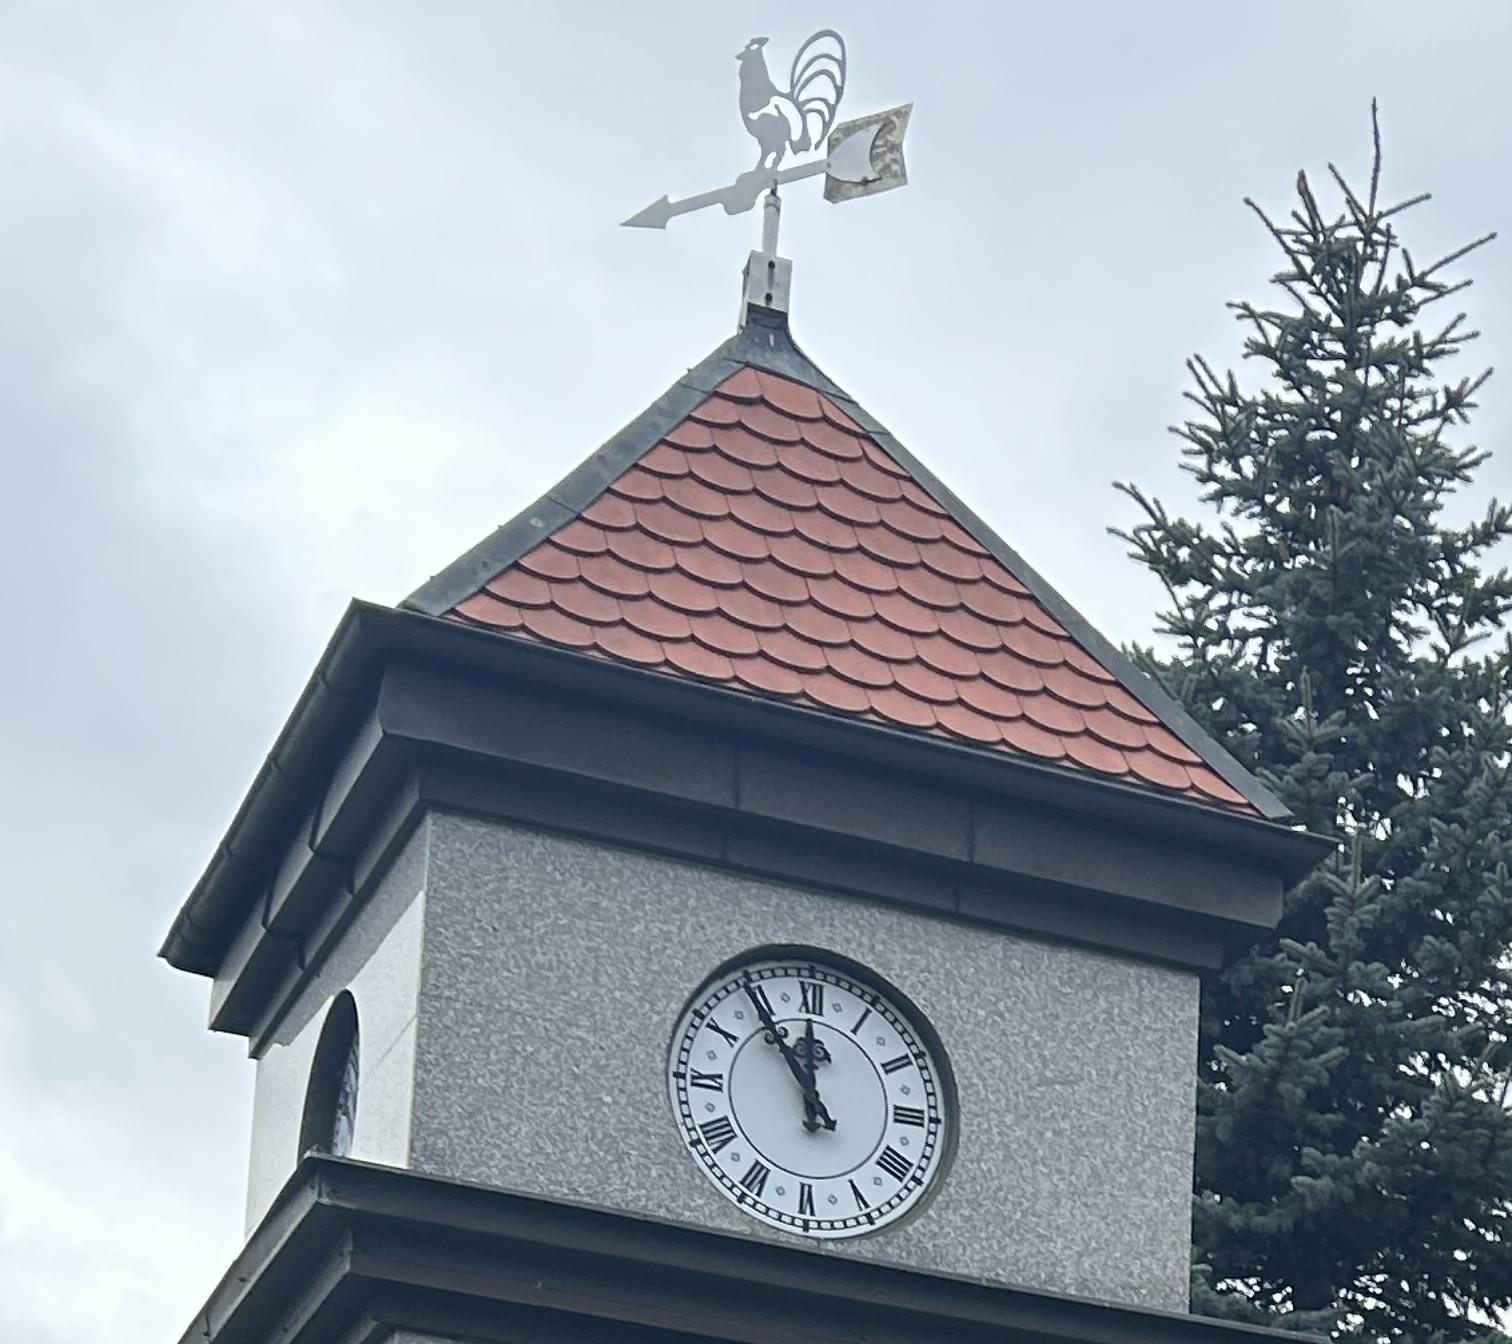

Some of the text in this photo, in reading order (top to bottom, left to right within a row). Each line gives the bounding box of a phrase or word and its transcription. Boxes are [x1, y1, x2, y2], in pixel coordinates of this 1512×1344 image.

[799, 980, 824, 1017] XII
[706, 1017, 739, 1048] X
[851, 1007, 872, 1035] I
[690, 1068, 723, 1093] IX
[880, 1054, 913, 1075] II
[893, 1105, 925, 1128] III
[698, 1115, 738, 1154] VIII
[739, 1159, 771, 1198] VII
[798, 1182, 816, 1217] VI
[848, 1179, 871, 1212] V
